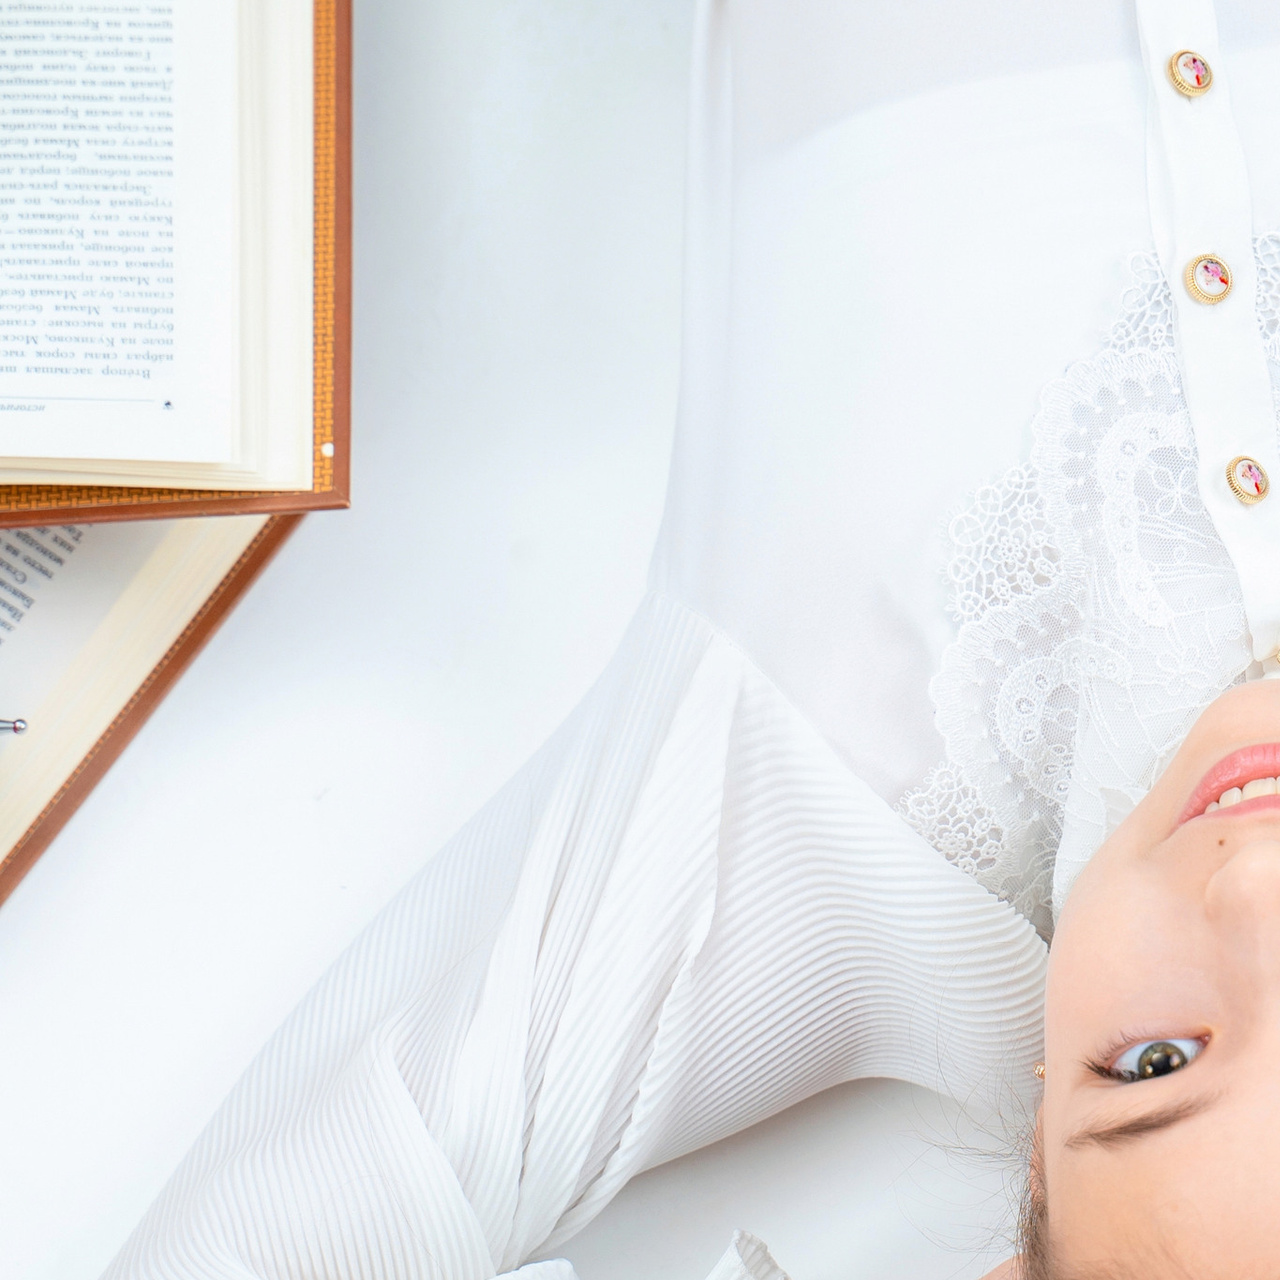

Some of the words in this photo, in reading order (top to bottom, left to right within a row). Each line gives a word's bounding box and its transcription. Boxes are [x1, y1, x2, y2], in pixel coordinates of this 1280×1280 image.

[29, 288, 76, 300] Мамай
[54, 304, 99, 315] Мамая
[44, 333, 114, 346] Куликово,
[141, 337, 173, 347] поле
[34, 348, 75, 359] сорок
[83, 351, 117, 360] силы
